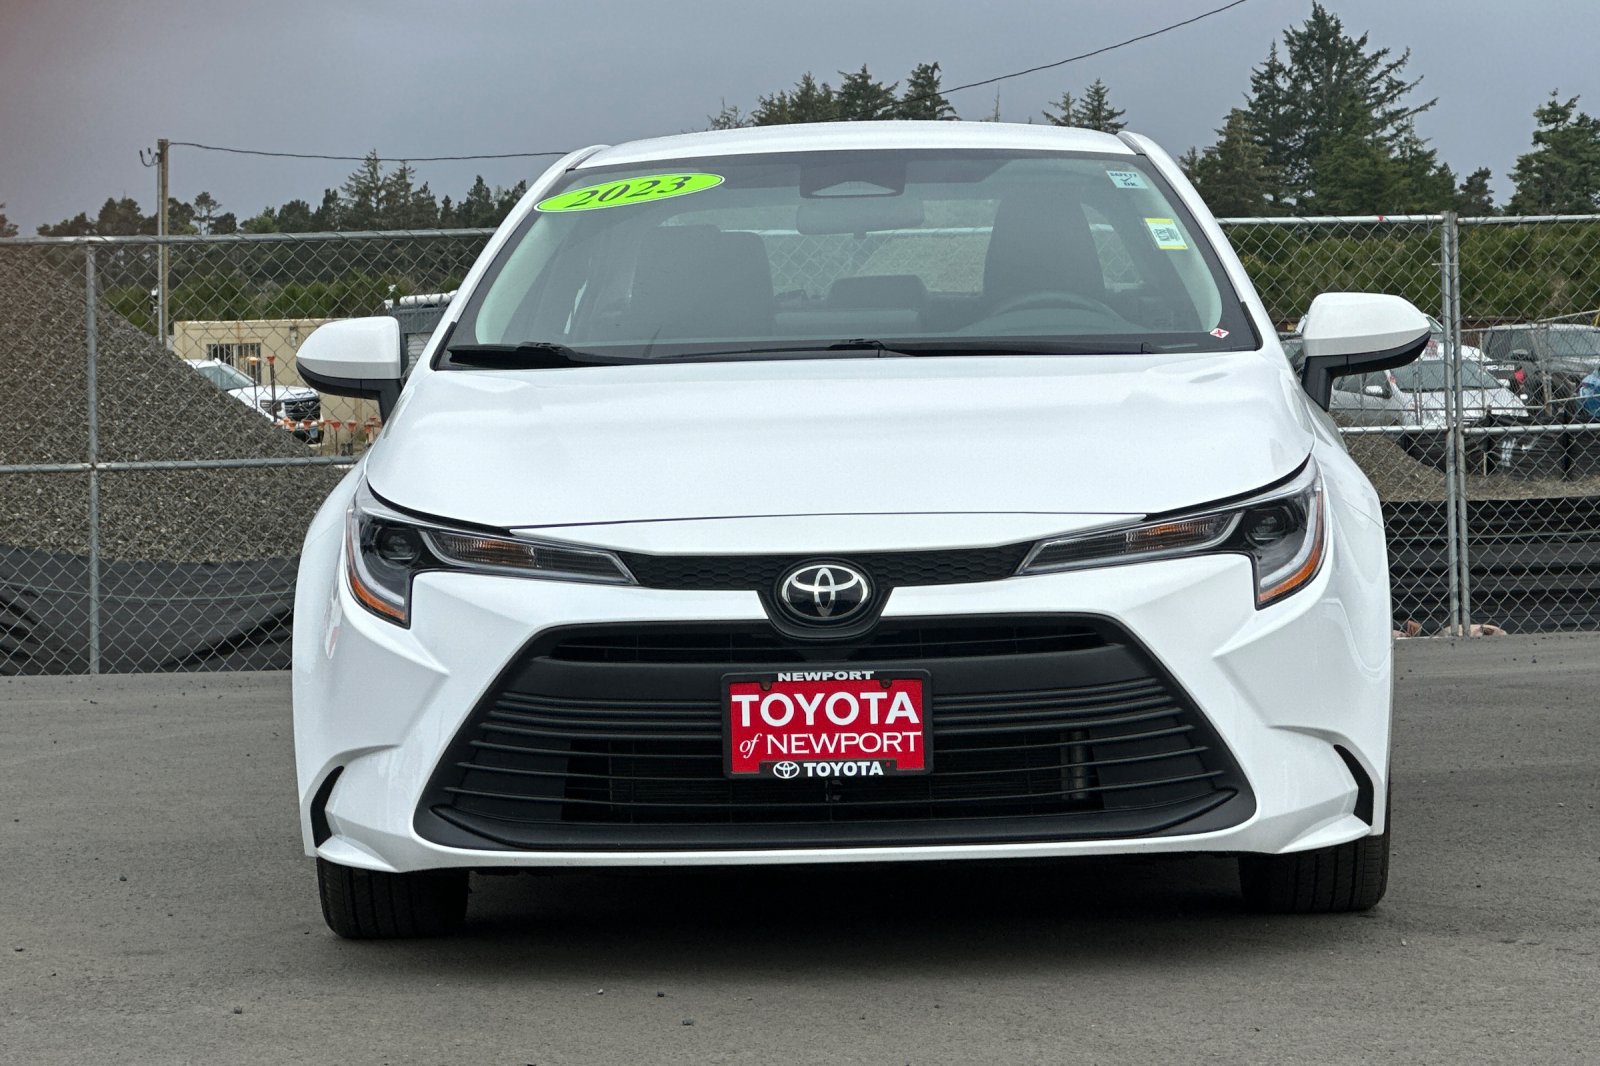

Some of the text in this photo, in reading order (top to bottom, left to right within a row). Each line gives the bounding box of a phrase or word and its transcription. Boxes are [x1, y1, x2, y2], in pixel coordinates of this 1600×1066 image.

[564, 176, 693, 209] 2023
[778, 670, 875, 682] NEWPORT
[731, 691, 920, 728] TOYOTA
[739, 731, 922, 758] of NEWPORT
[803, 761, 884, 777] TOYOTA
